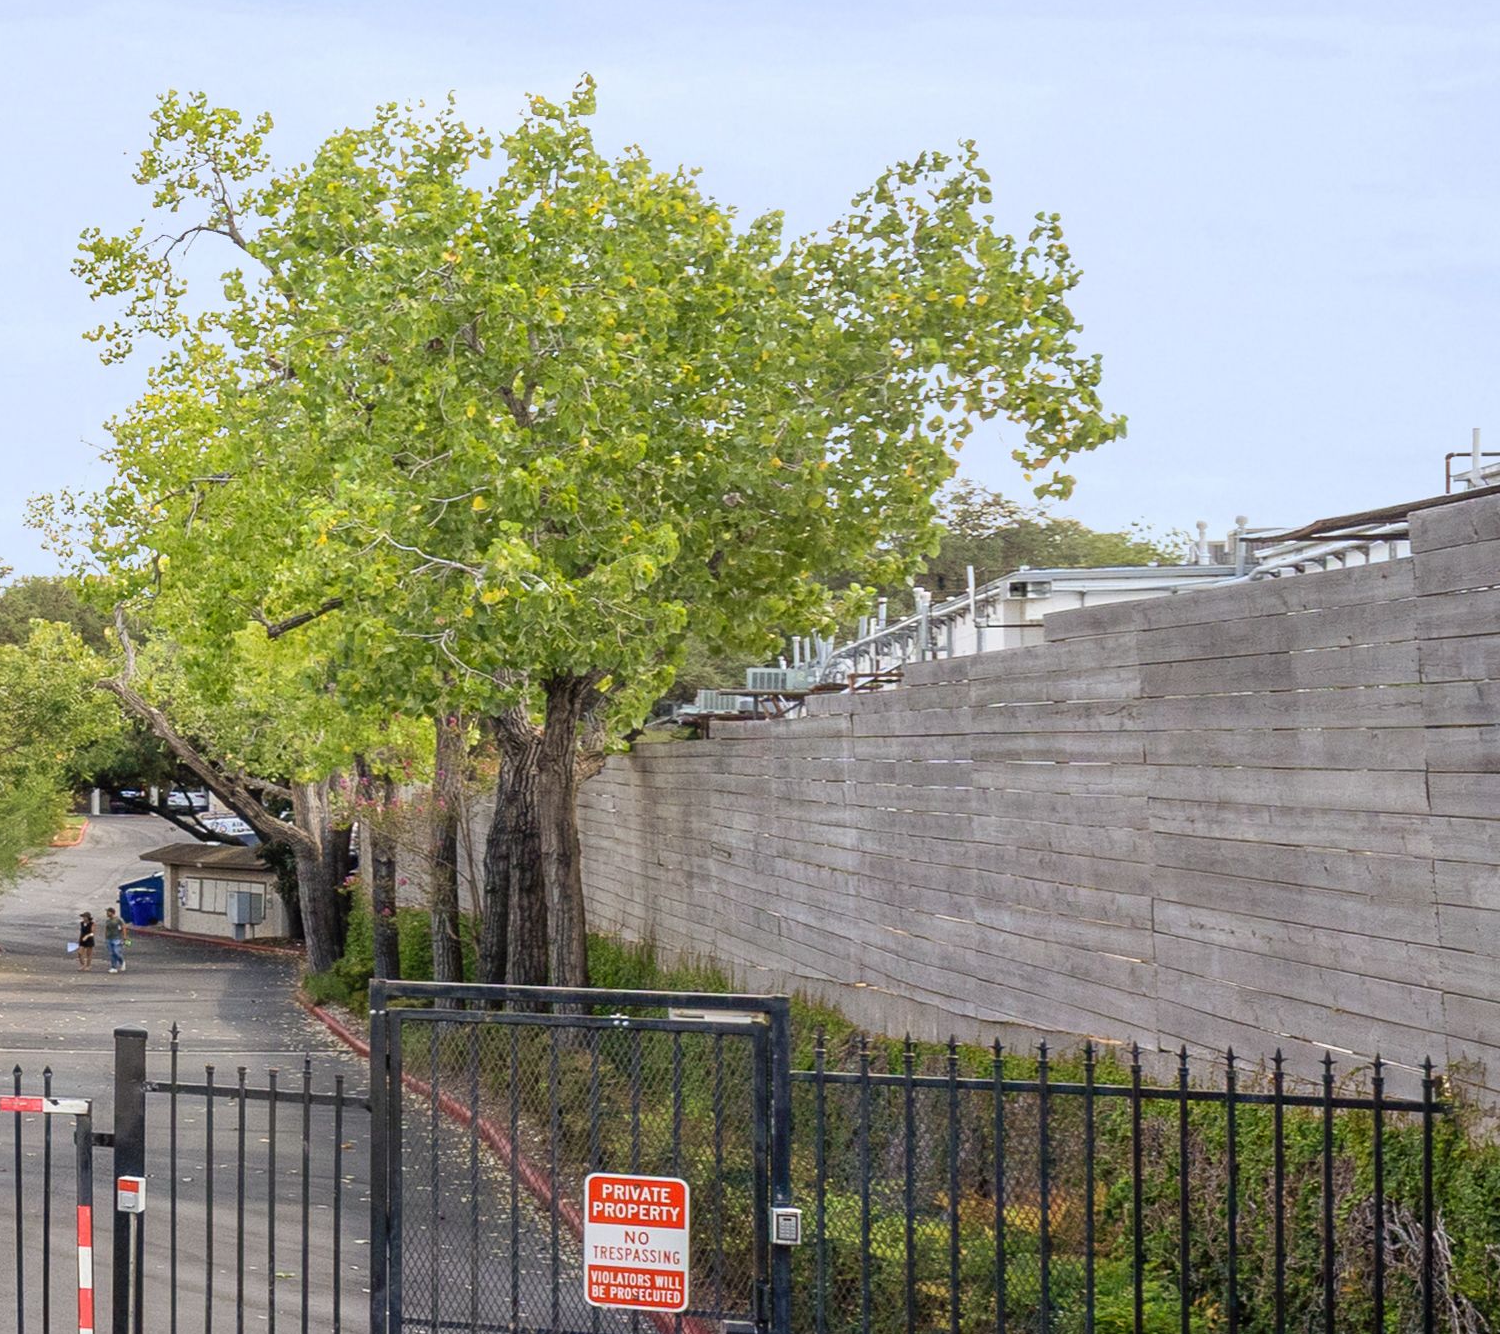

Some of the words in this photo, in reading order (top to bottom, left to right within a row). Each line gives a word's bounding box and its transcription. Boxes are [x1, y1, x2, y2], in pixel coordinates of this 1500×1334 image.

[602, 1184, 671, 1203] PRIVATE
[592, 1202, 680, 1222] PROPERTY
[624, 1231, 649, 1245] NO
[593, 1246, 680, 1265] TRESPASSING
[591, 1270, 651, 1286] VIOLATORS
[654, 1275, 682, 1290] WILL
[591, 1285, 606, 1298] BE
[610, 1287, 681, 1303] PROSECUTED
